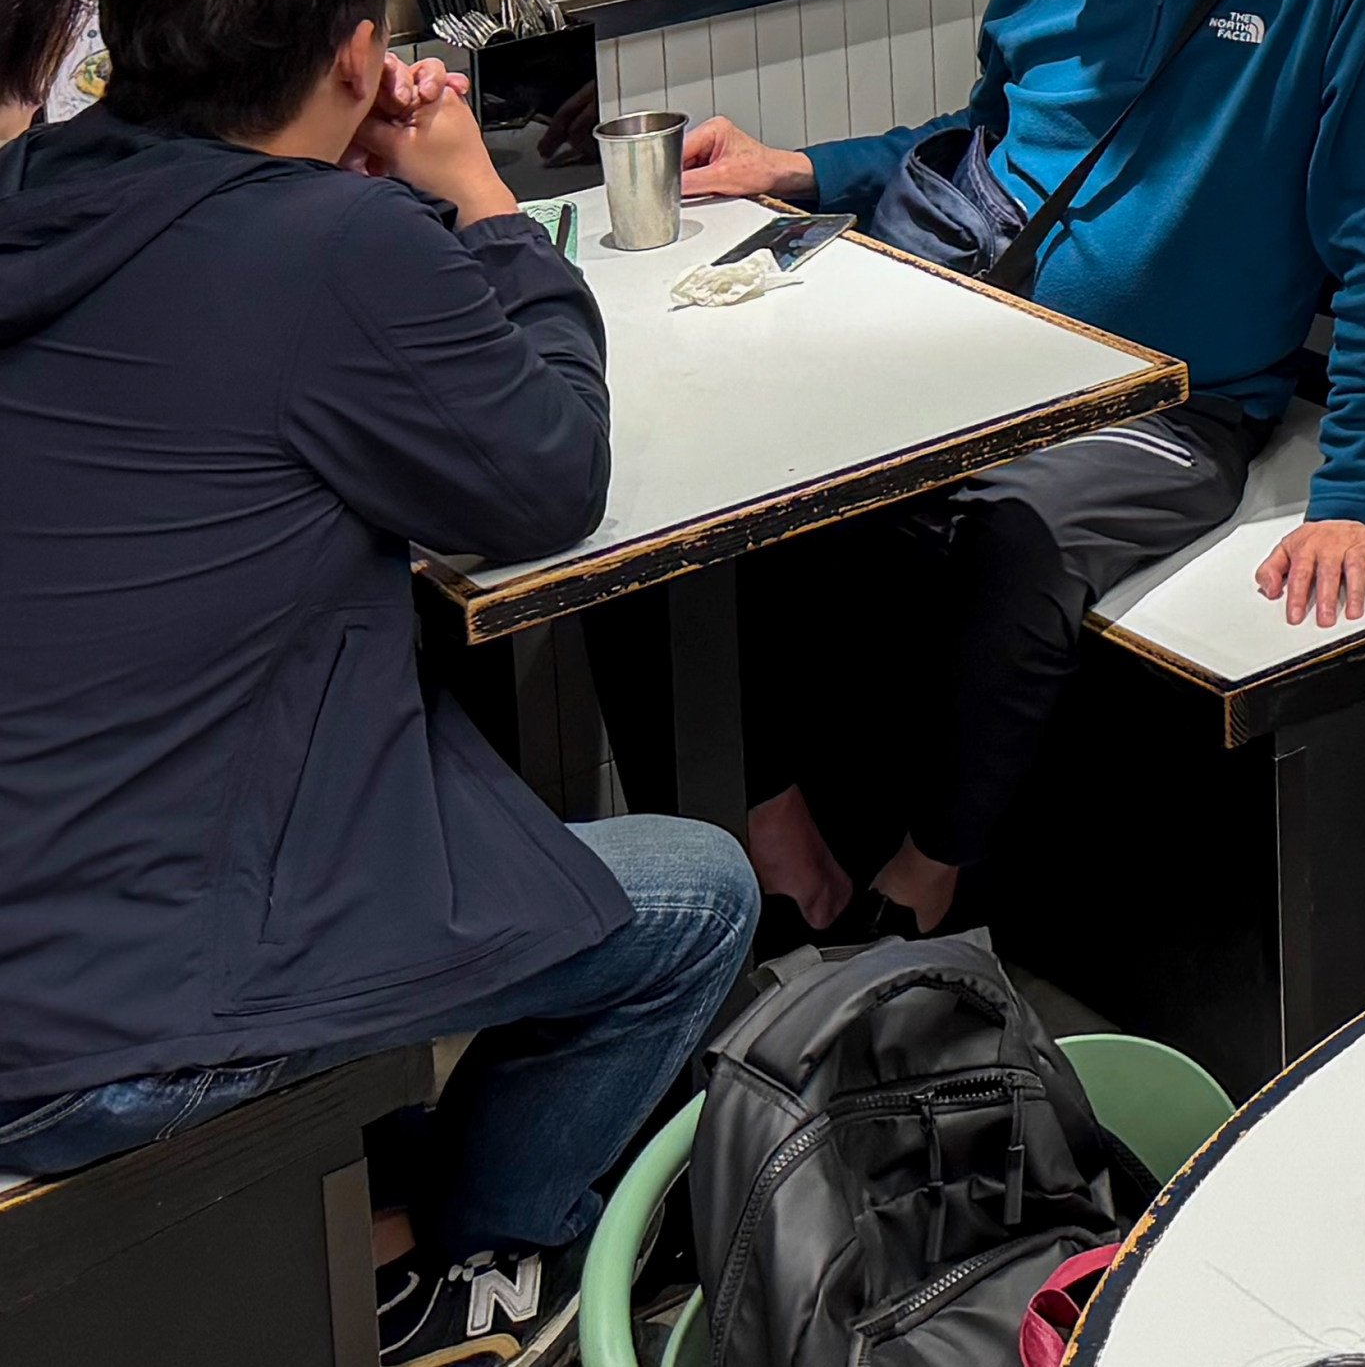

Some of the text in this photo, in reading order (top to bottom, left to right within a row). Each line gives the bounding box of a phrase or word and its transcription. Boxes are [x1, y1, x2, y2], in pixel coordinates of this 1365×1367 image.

[1229, 11, 1252, 23] THE
[1209, 17, 1251, 32] NORTH
[1217, 29, 1251, 42] FACE
